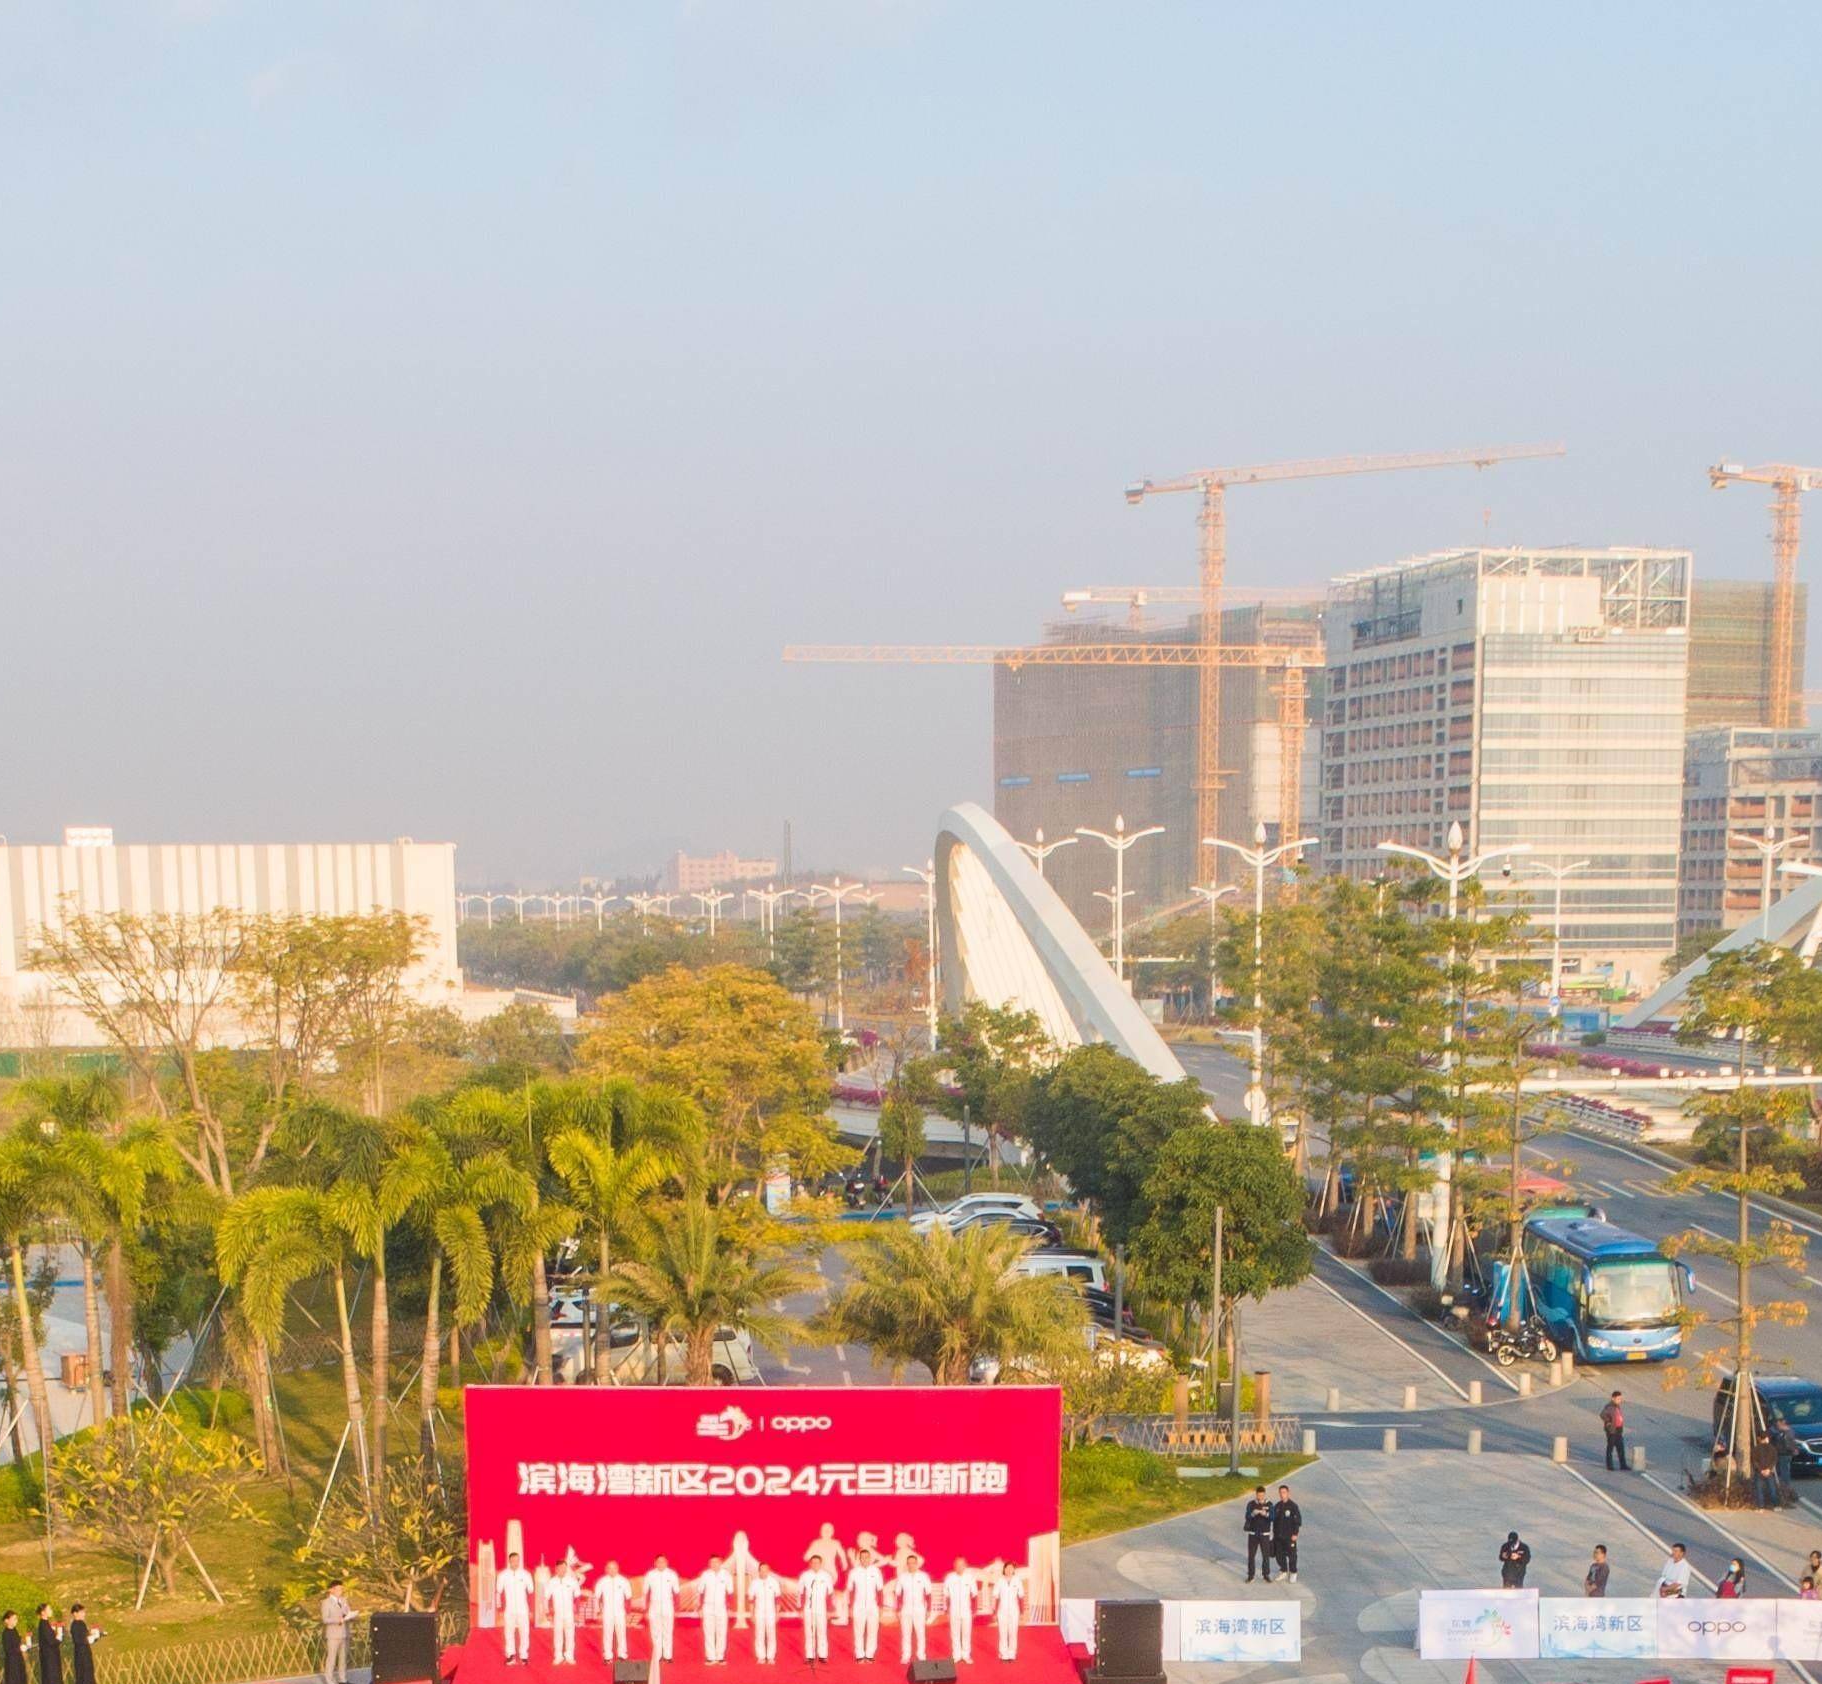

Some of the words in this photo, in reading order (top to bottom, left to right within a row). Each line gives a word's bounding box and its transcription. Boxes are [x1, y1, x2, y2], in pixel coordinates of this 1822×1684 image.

[517, 1462, 1008, 1497] 滨海湾新区2024元旦迎新跑
[1195, 1618, 1286, 1636] 滨海湾新区
[1554, 1614, 1643, 1633] 滨海湾新区
